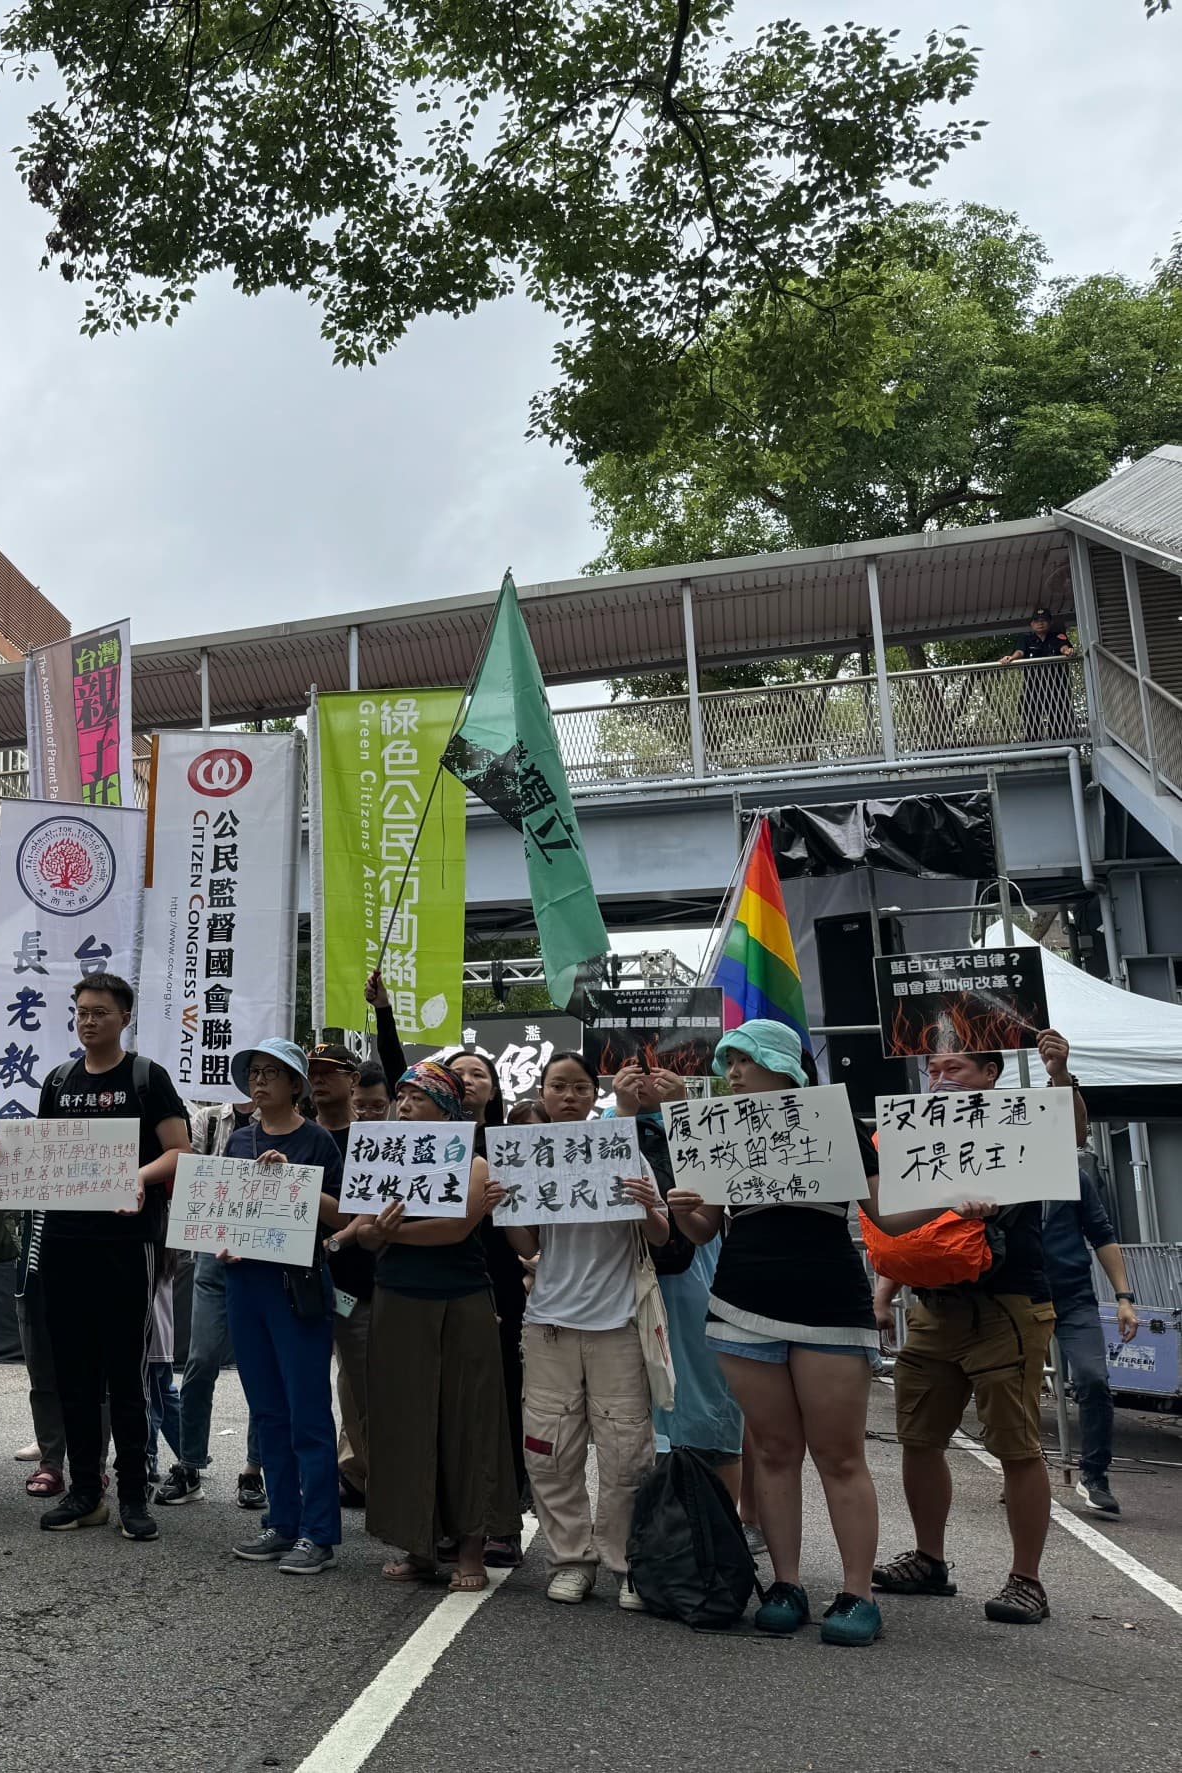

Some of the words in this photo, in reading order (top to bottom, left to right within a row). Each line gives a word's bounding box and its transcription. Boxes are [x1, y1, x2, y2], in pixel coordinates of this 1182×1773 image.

[37, 655, 46, 675] The
[76, 638, 120, 675] 台灣
[42, 677, 55, 735] Association
[46, 737, 57, 748] of
[358, 700, 376, 760] Green
[48, 749, 58, 784] Parent
[189, 809, 210, 888] CITIZEN
[379, 698, 421, 1033] 綠色公民行動聯盟
[54, 889, 75, 898] 1865
[363, 864, 376, 929] Action
[162, 896, 179, 1020] http://www.ccw.org.tw/
[184, 894, 205, 999] CONGRESS
[199, 809, 240, 1085] 公民監督國會聯盟
[890, 953, 1021, 976] 藍白立委不自律？
[892, 974, 1024, 997] 國會要如何改革？
[178, 1004, 199, 1084] WATCH
[350, 1134, 467, 1167] 抗議藍白
[493, 1132, 633, 1169] 沒有討論
[901, 1141, 1026, 1182] 不是民主！
[345, 1172, 464, 1205] 沒收民主
[499, 1175, 636, 1214] 不是民主
